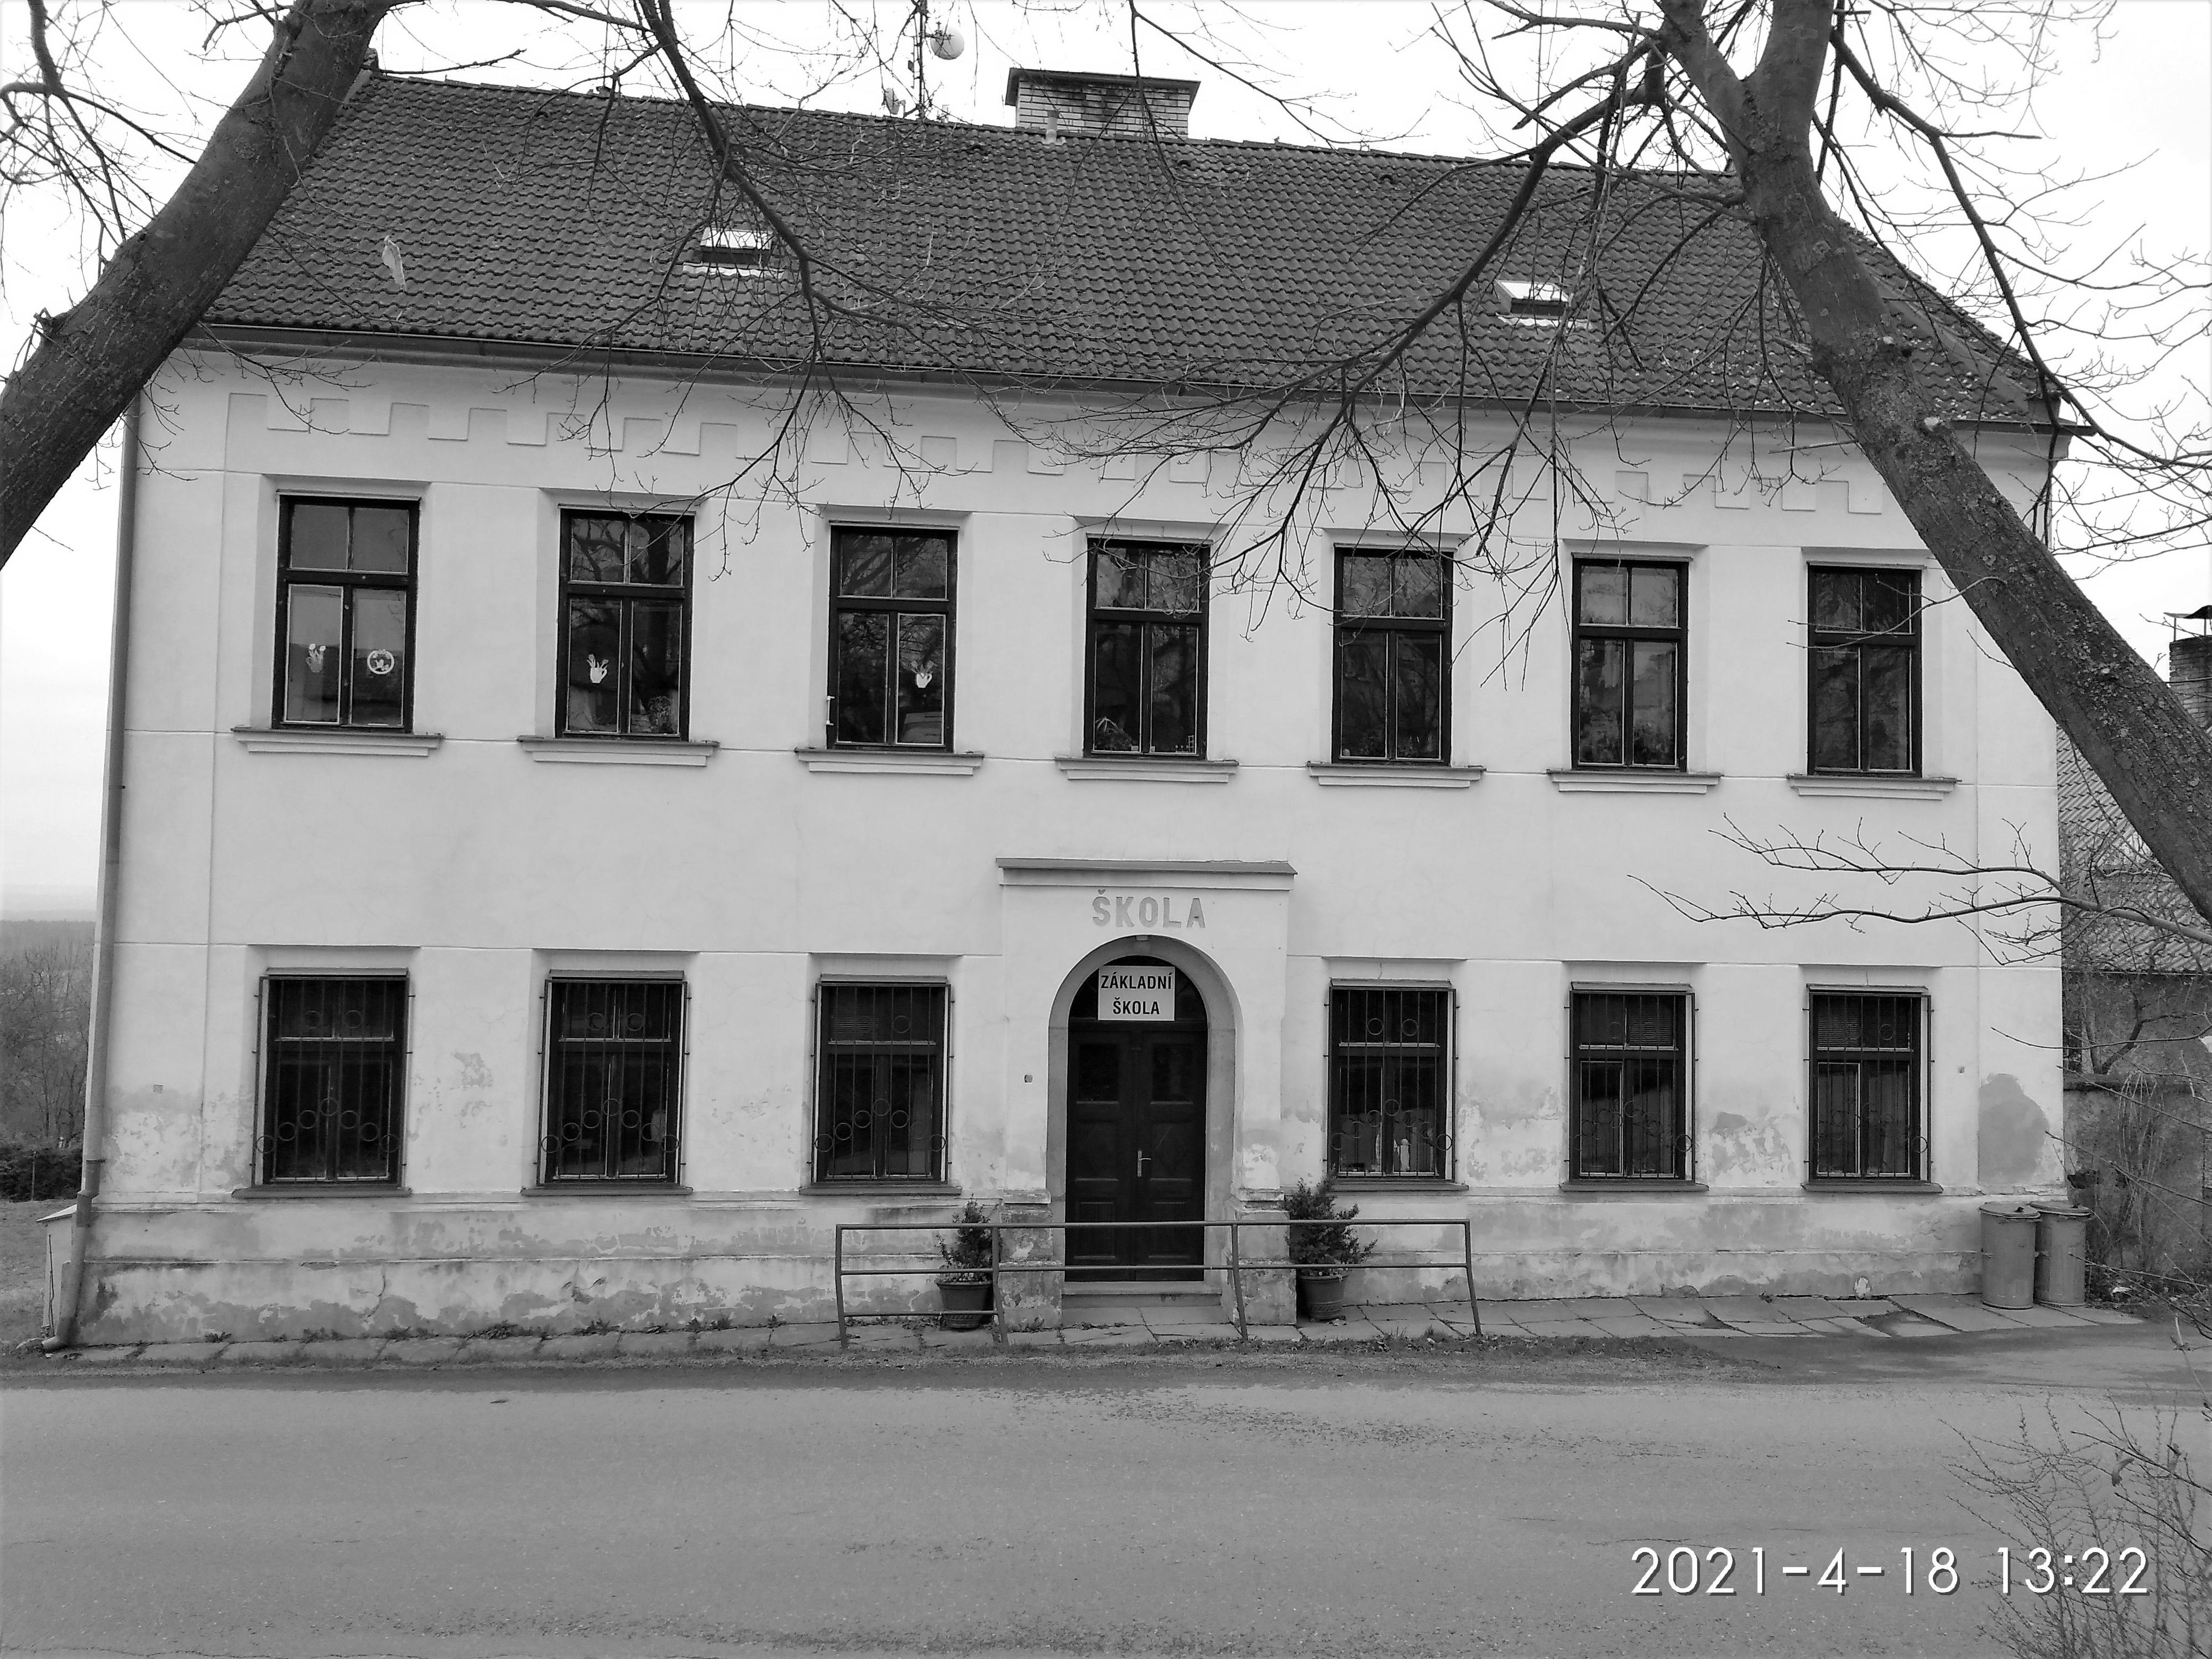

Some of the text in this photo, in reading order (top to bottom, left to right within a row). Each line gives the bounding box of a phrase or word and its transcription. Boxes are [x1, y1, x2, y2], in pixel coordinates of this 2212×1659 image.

[1092, 889, 1206, 928] ŠKOLA
[1100, 972, 1172, 990] ZÁKLADNÍ
[1112, 997, 1160, 1015] ŠKOLA
